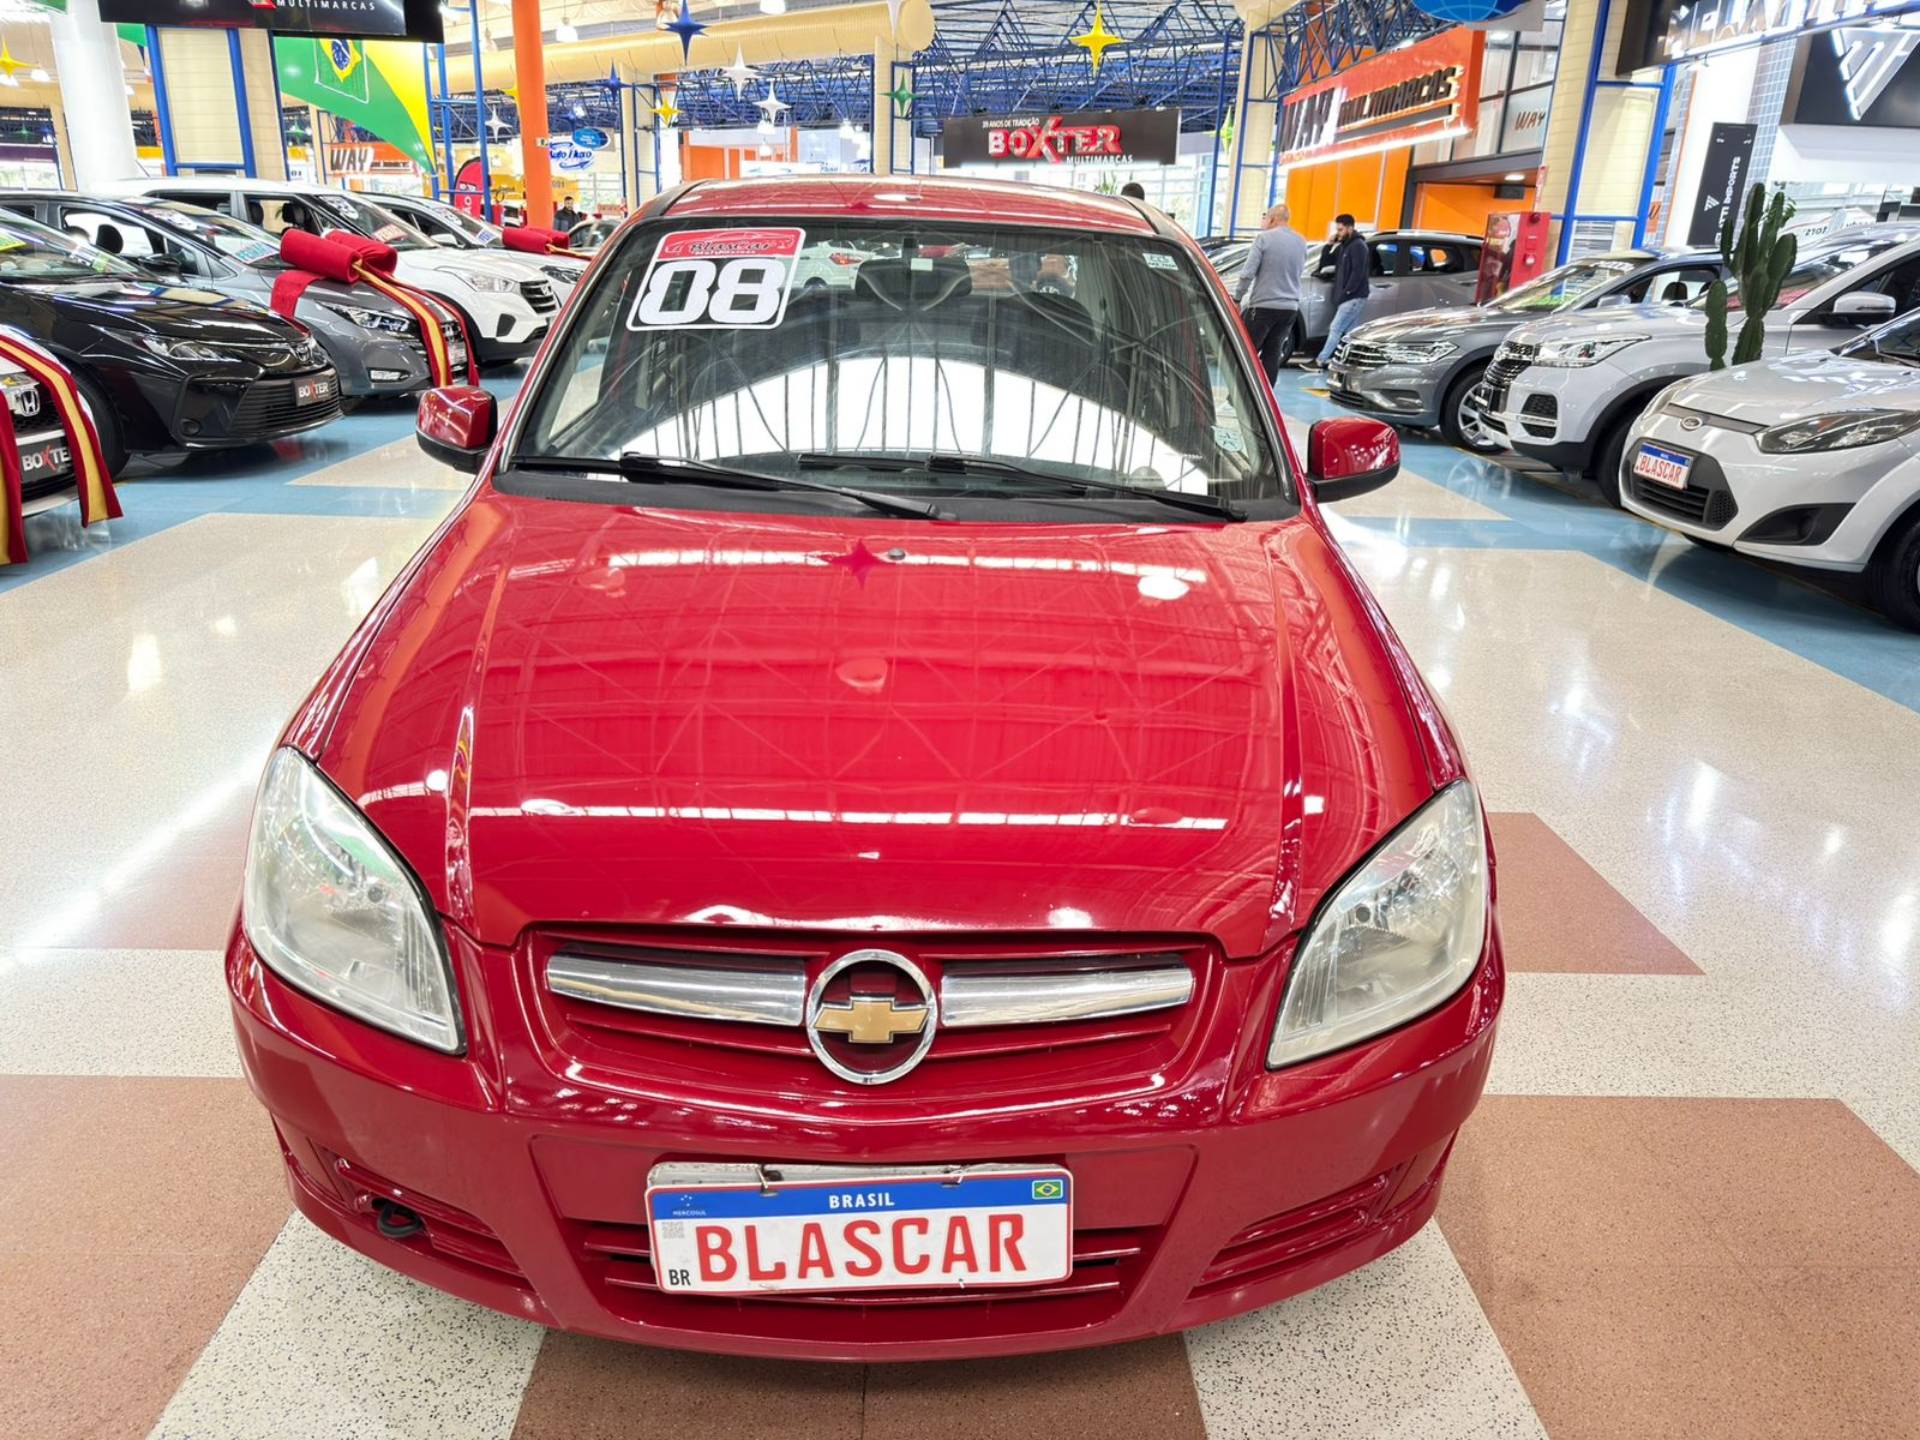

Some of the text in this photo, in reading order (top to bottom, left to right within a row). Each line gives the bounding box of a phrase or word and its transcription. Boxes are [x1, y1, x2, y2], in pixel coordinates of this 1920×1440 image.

[277, 0, 375, 10] MULTIMARCAS
[1281, 66, 1458, 152] WAY MULTIMARCAS
[1514, 111, 1546, 130] WAY
[988, 116, 1122, 164] BOXTER
[330, 147, 370, 171] WAY
[1066, 155, 1133, 165] MULTIMARCAS
[638, 258, 786, 325] 08
[298, 380, 329, 400] BOXTER
[1639, 455, 1682, 482] BLASCAR
[829, 1192, 895, 1209] BRASIL
[695, 1213, 1027, 1282] BLASCAR
[668, 1269, 691, 1286] BR
